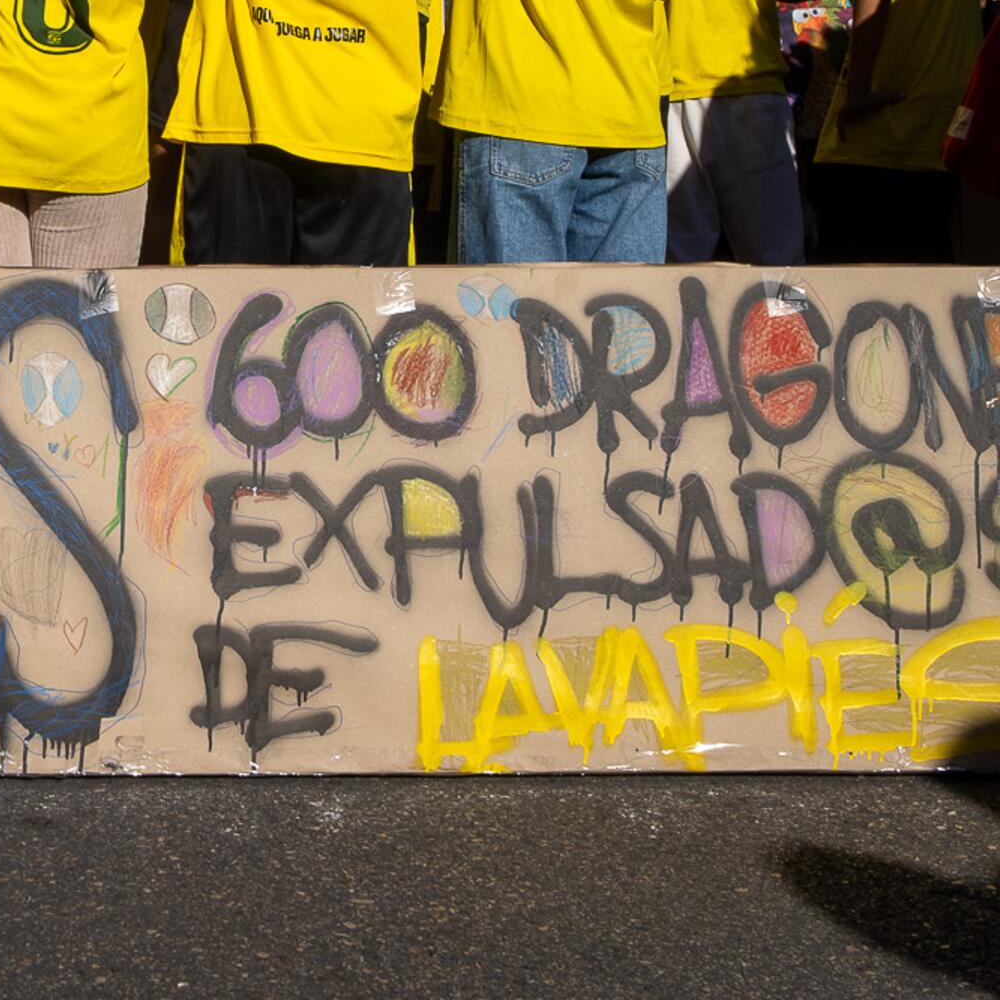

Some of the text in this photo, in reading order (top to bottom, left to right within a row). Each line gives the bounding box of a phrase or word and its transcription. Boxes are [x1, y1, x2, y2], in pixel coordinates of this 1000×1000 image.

[206, 276, 1000, 454] 600 DRAGON
[203, 450, 1000, 632] EXPULSAD@
[189, 624, 379, 753] DE
